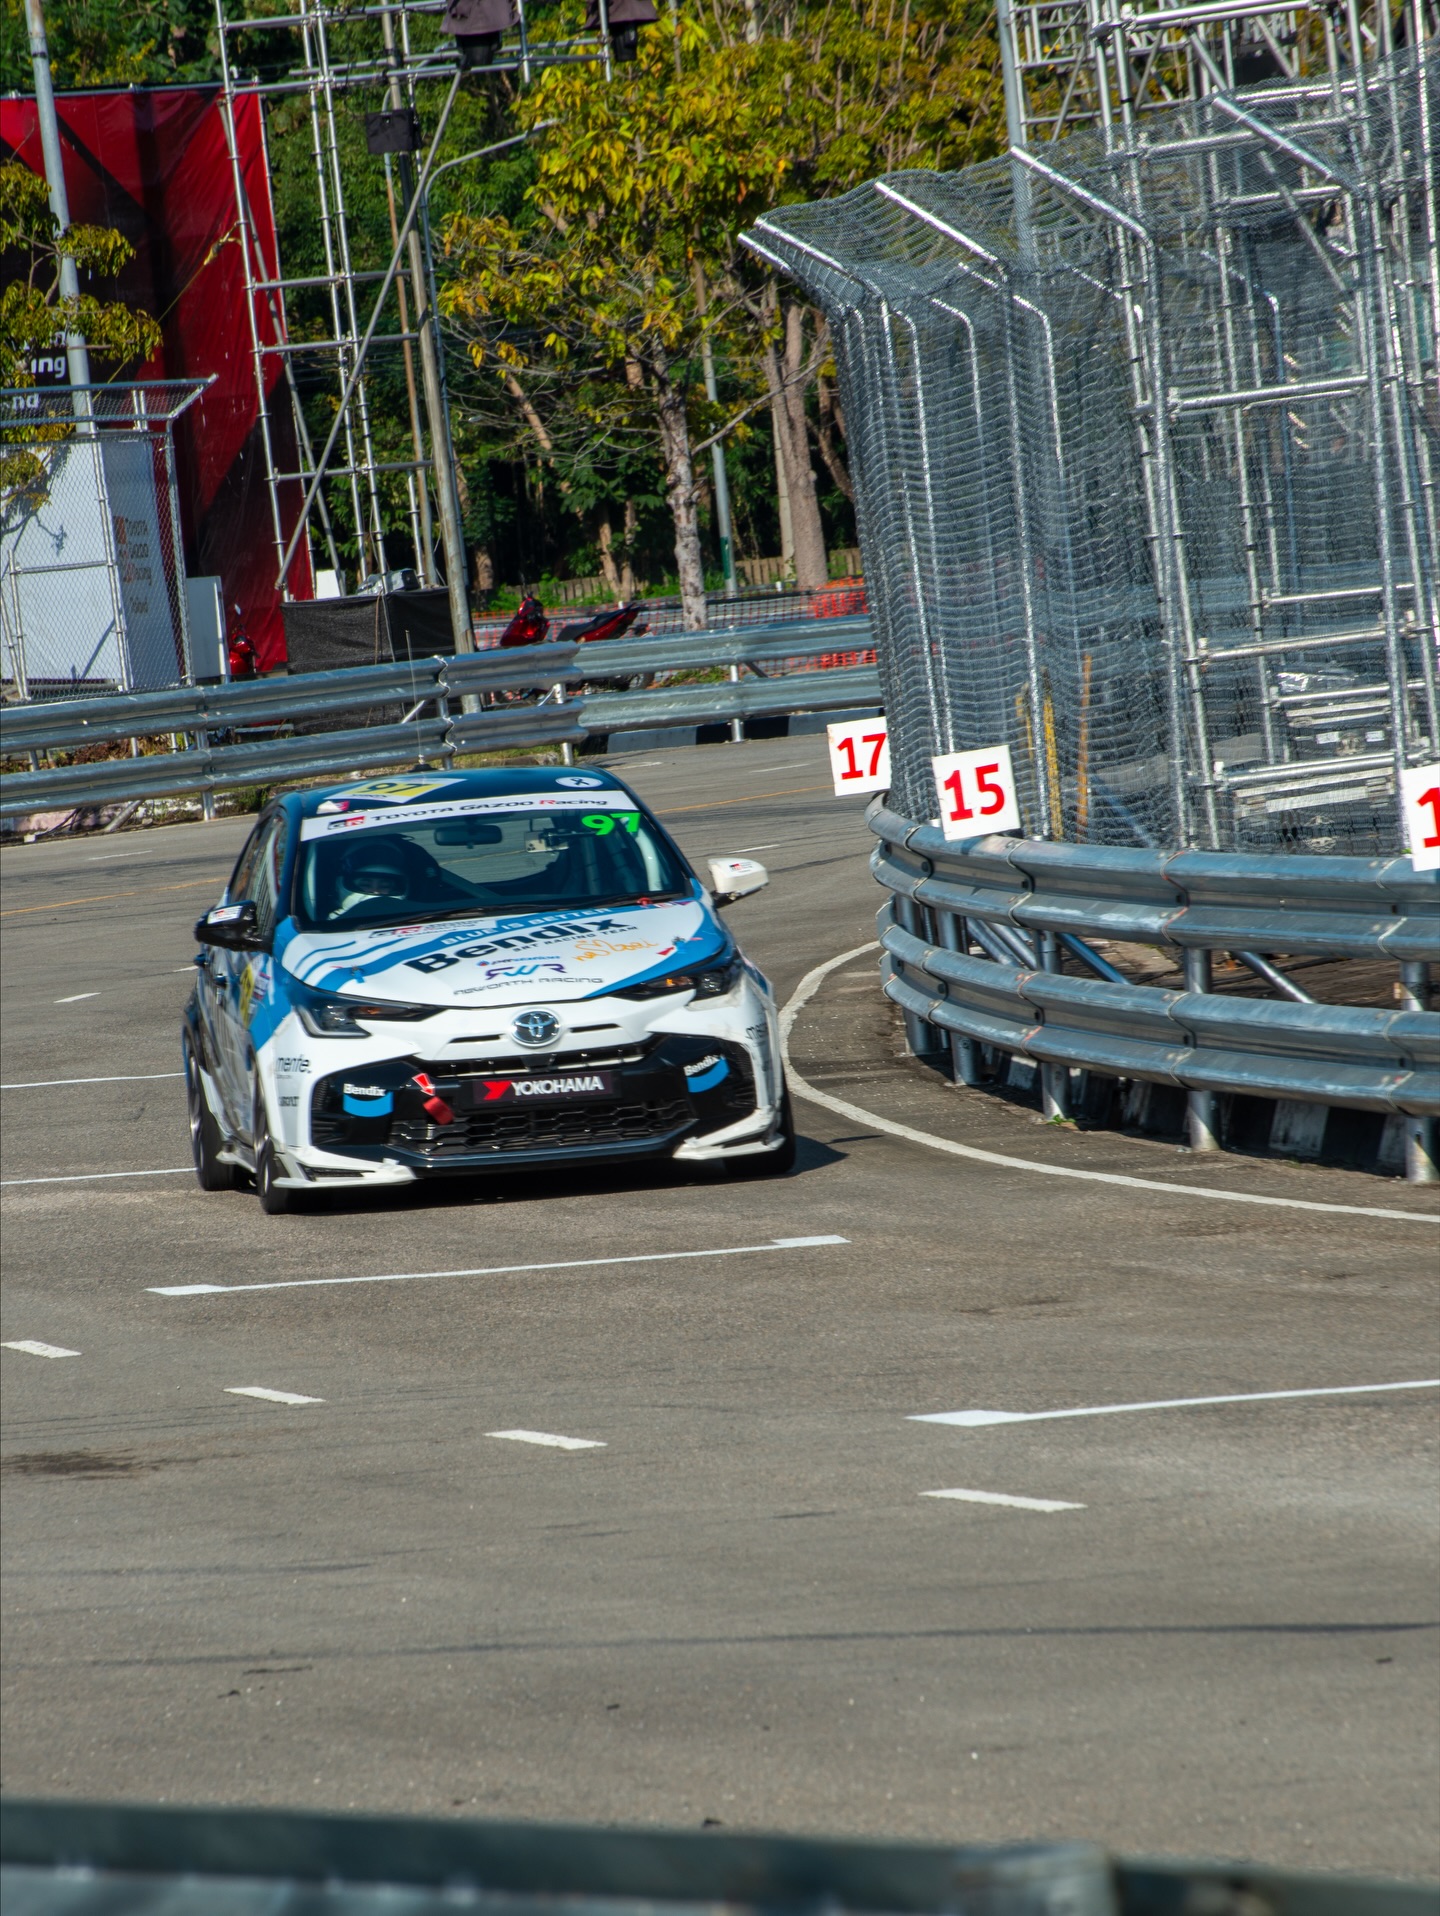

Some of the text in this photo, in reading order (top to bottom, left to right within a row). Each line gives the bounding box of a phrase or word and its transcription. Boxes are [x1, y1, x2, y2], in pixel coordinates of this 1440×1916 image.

[837, 733, 887, 780] 17
[944, 763, 1005, 821] 15
[371, 807, 454, 821] TOYOTA
[459, 800, 534, 811] GAZOO
[539, 798, 608, 806] Racing
[581, 812, 642, 836] 97
[440, 927, 499, 946] BLUE
[501, 921, 525, 931] IS
[527, 907, 611, 926] BETTER
[544, 933, 597, 945] RACING
[600, 926, 638, 936] TEAM
[403, 918, 632, 974] Bendix
[682, 1054, 721, 1077] Bendix
[343, 1083, 387, 1097] Bendix
[511, 1076, 605, 1096] YOKOHAMA
